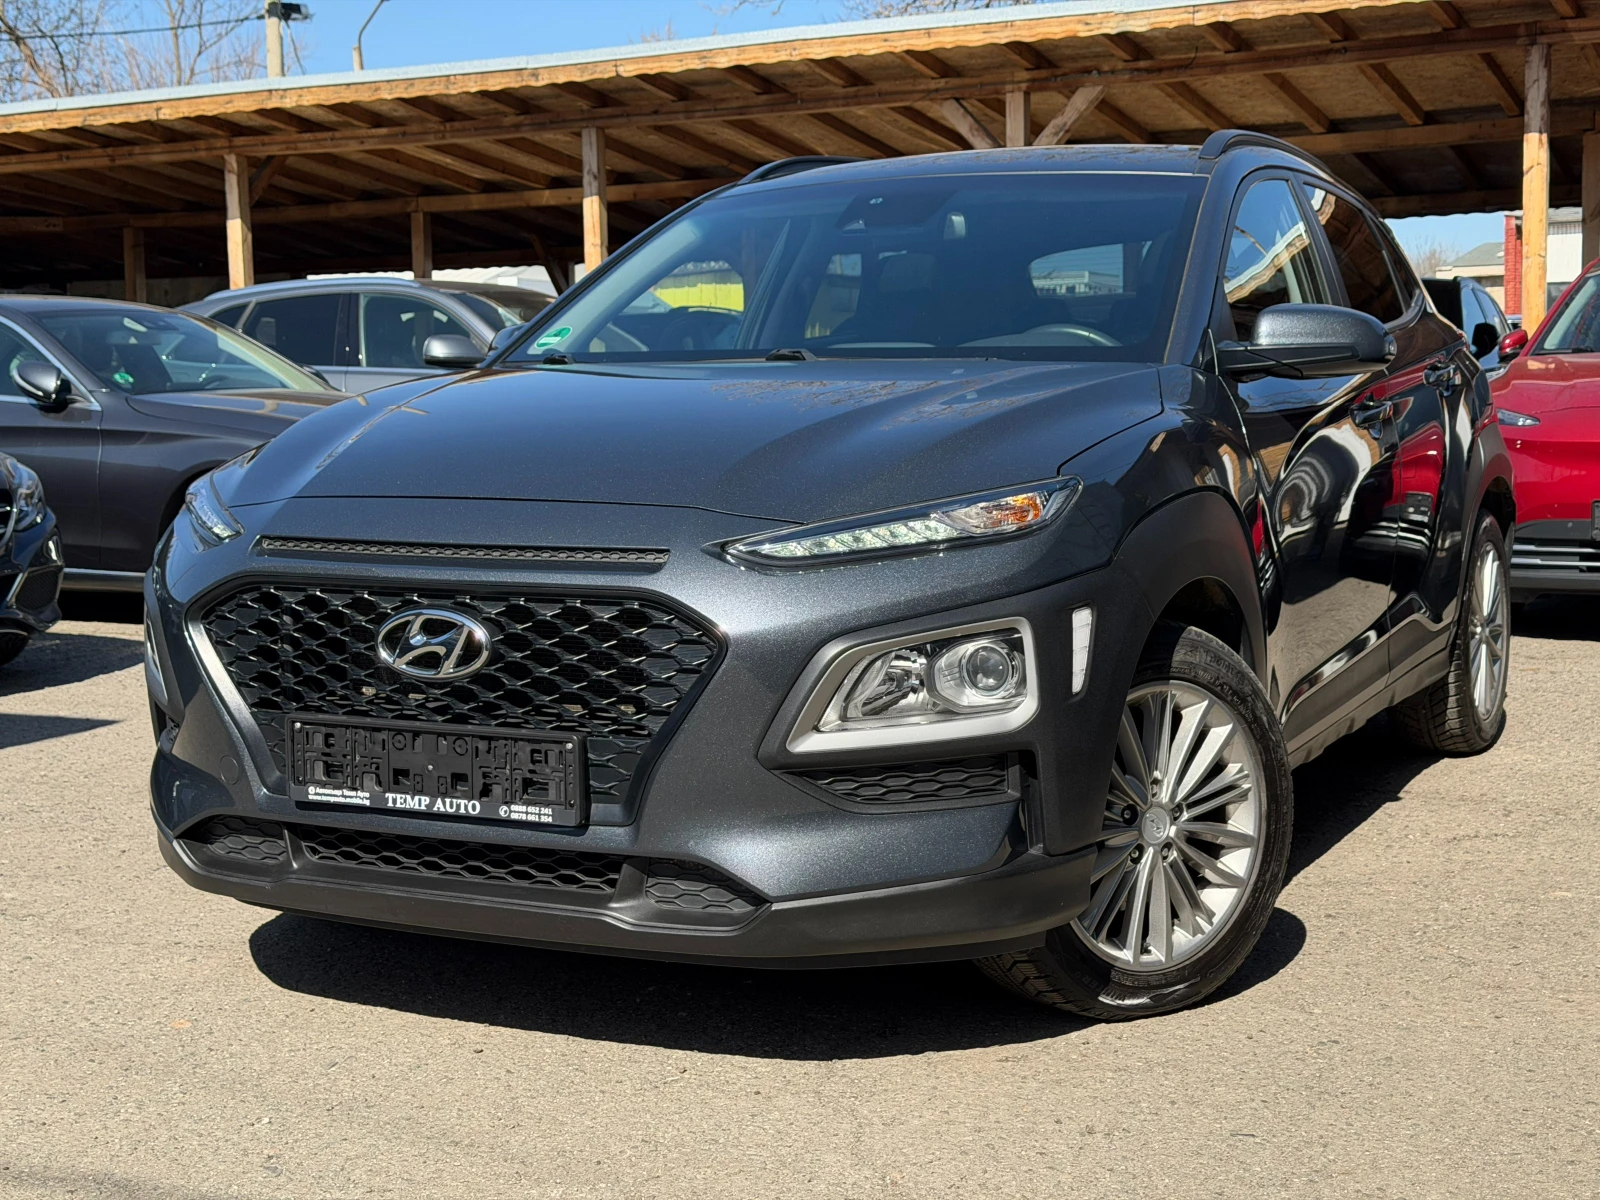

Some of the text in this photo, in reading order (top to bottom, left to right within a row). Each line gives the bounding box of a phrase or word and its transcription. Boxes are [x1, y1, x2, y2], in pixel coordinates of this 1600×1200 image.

[385, 793, 481, 814] TEMP AUTO
[510, 804, 553, 815] 0888 652 241
[510, 812, 553, 823] 0878 661 354
